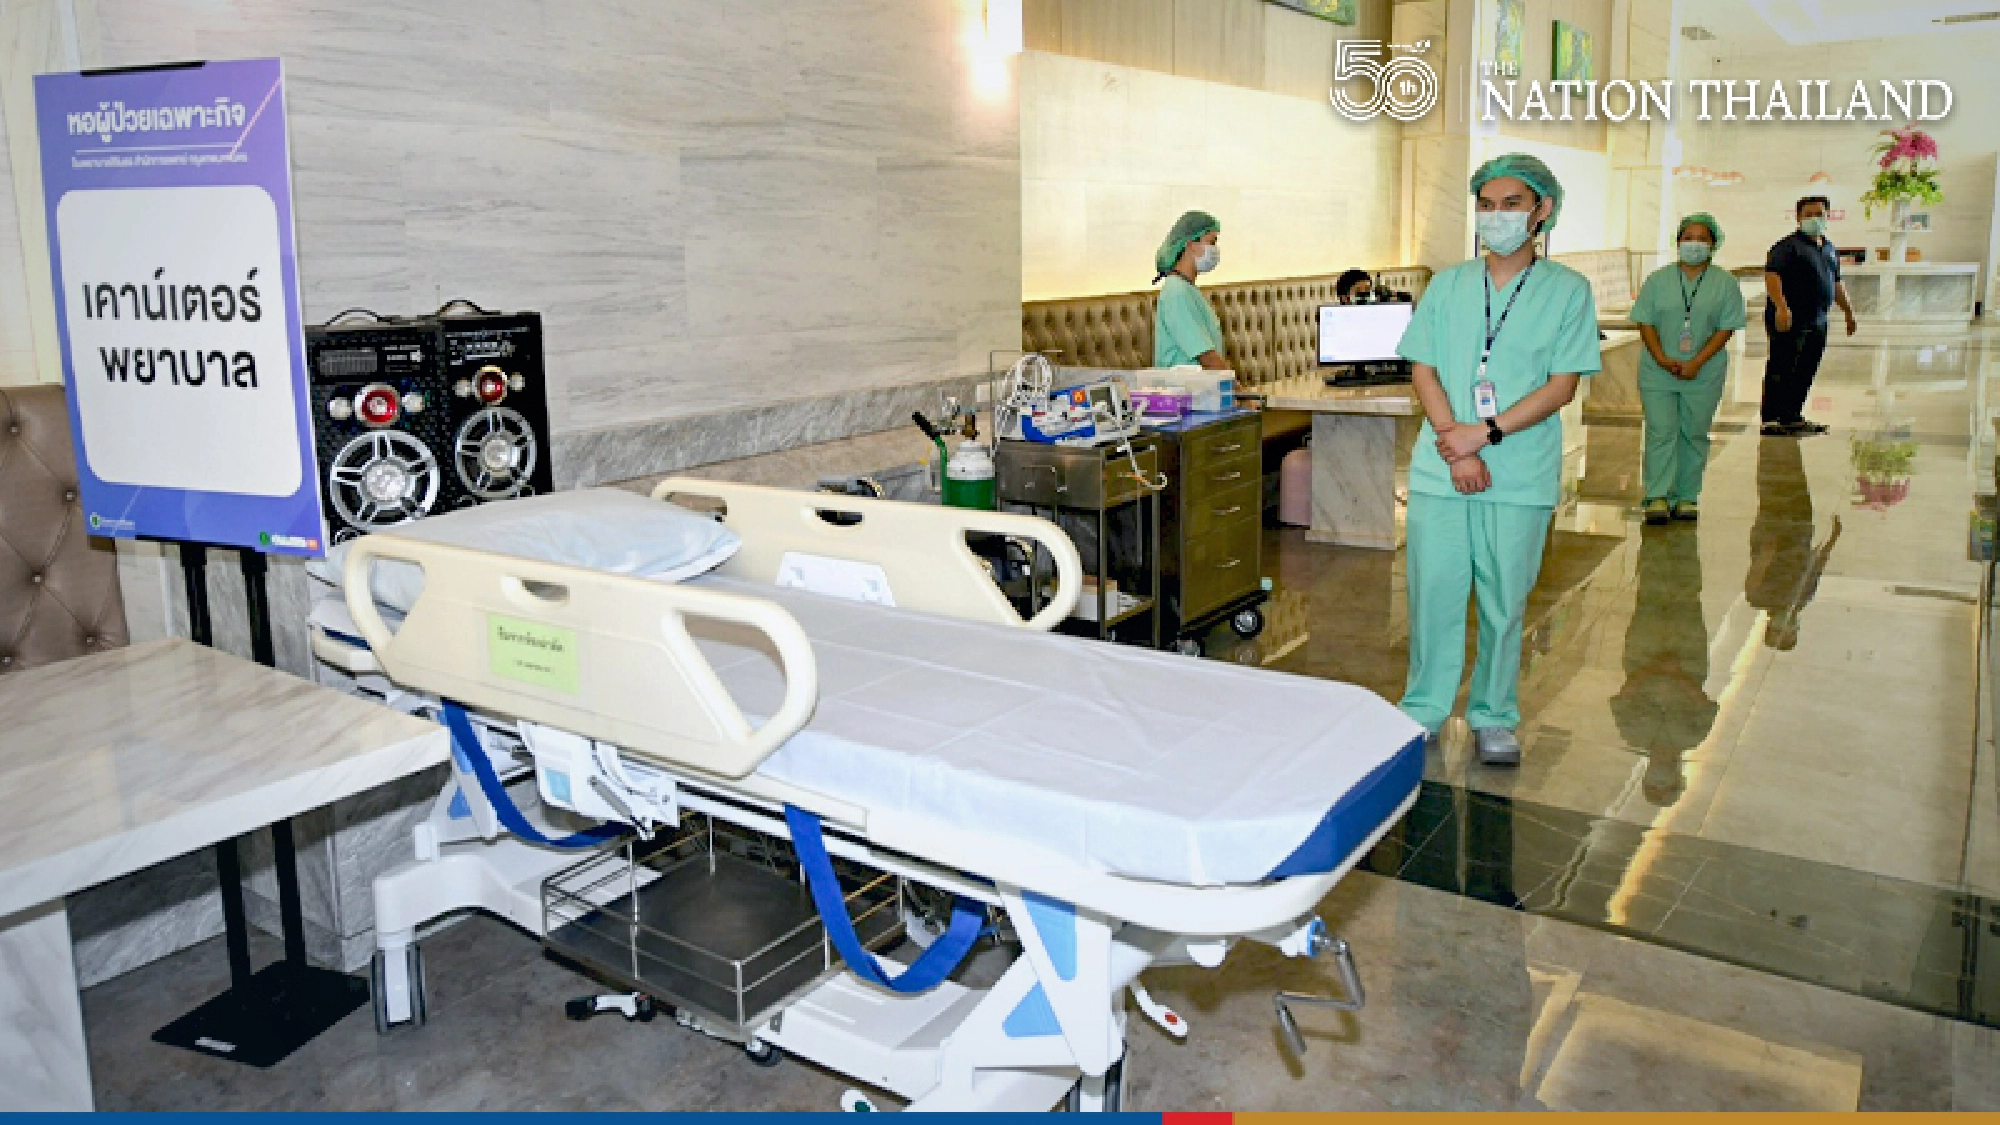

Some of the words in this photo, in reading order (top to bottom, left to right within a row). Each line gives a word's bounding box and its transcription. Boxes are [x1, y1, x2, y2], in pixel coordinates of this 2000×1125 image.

[82, 266, 262, 323] เคาน์เตอร์
[98, 346, 259, 389] พยาบาล
